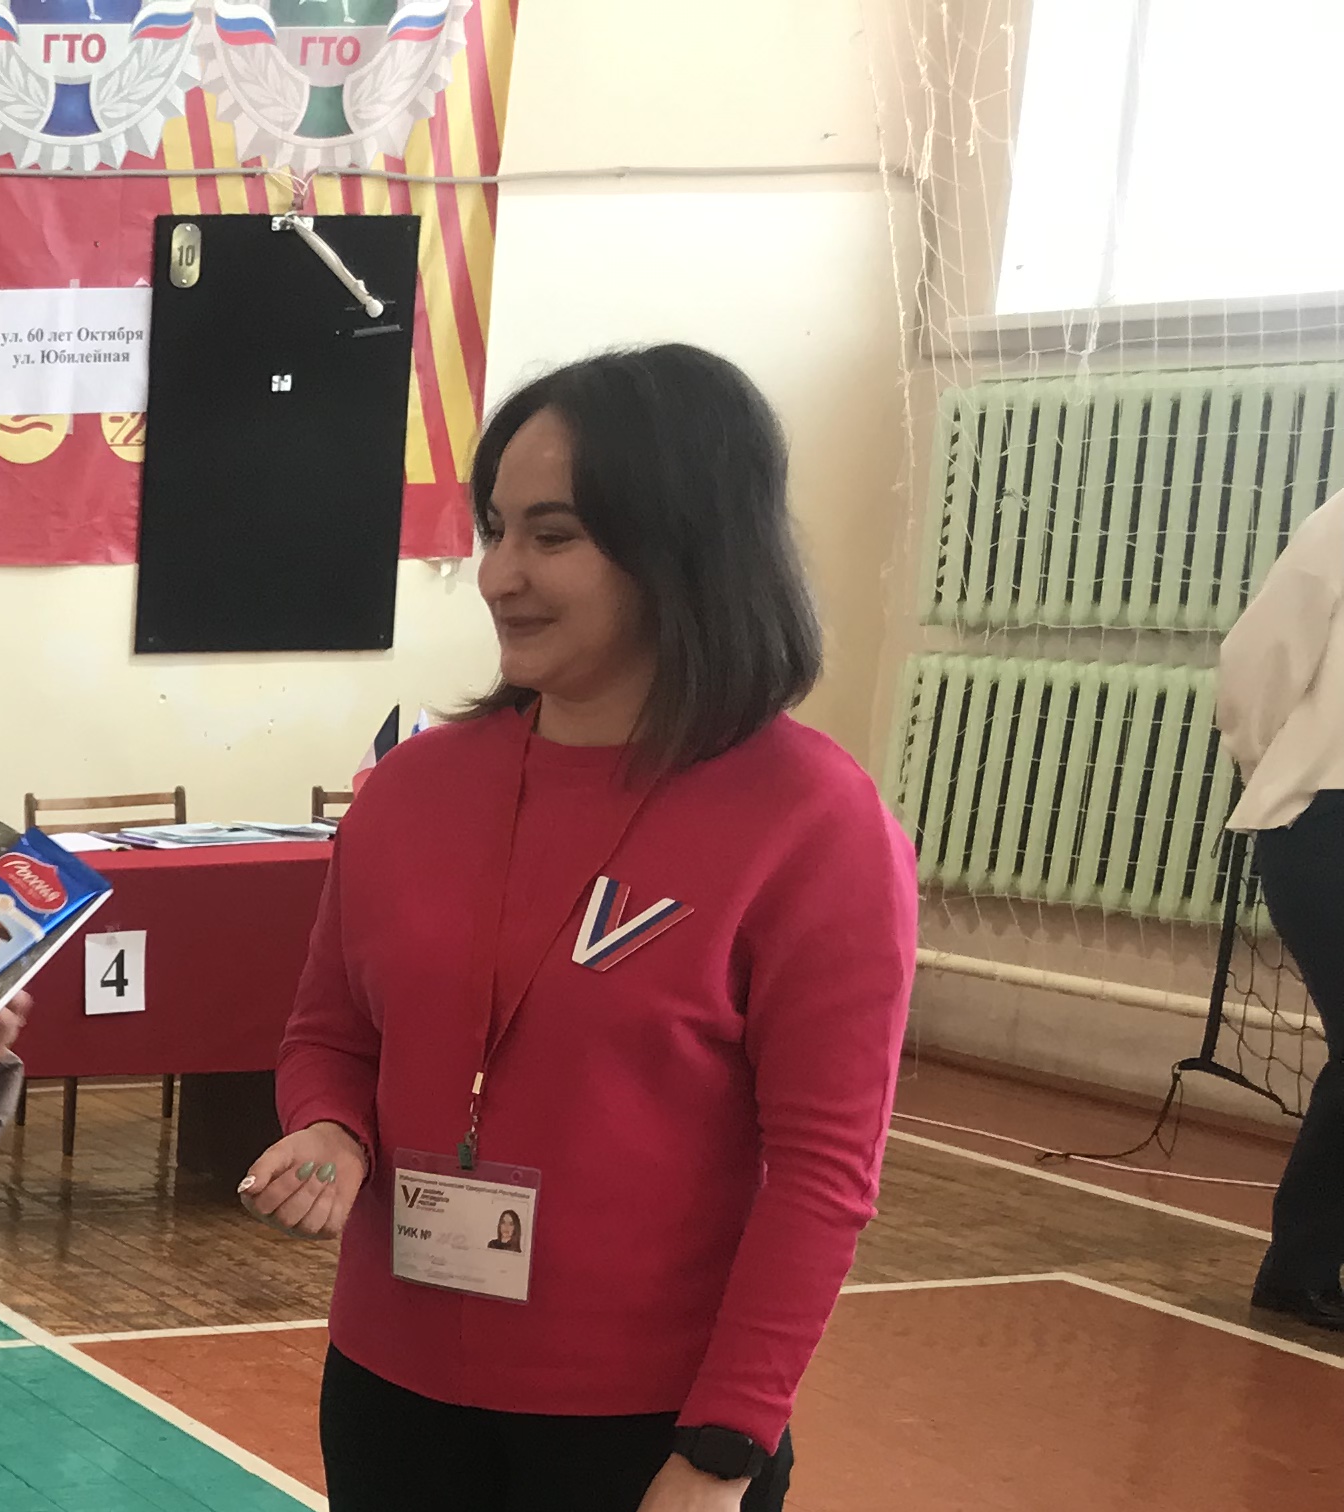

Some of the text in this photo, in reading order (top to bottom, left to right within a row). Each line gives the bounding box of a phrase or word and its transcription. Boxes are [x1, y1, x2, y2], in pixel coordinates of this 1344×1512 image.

[43, 33, 107, 64] ГТО
[299, 35, 361, 66] ГТО
[177, 245, 195, 267] 10
[0, 327, 144, 347] ул. 60 лет Октября
[12, 349, 130, 369] ул. Юбилейная
[100, 949, 128, 997] 4
[396, 1223, 418, 1239] УИК
